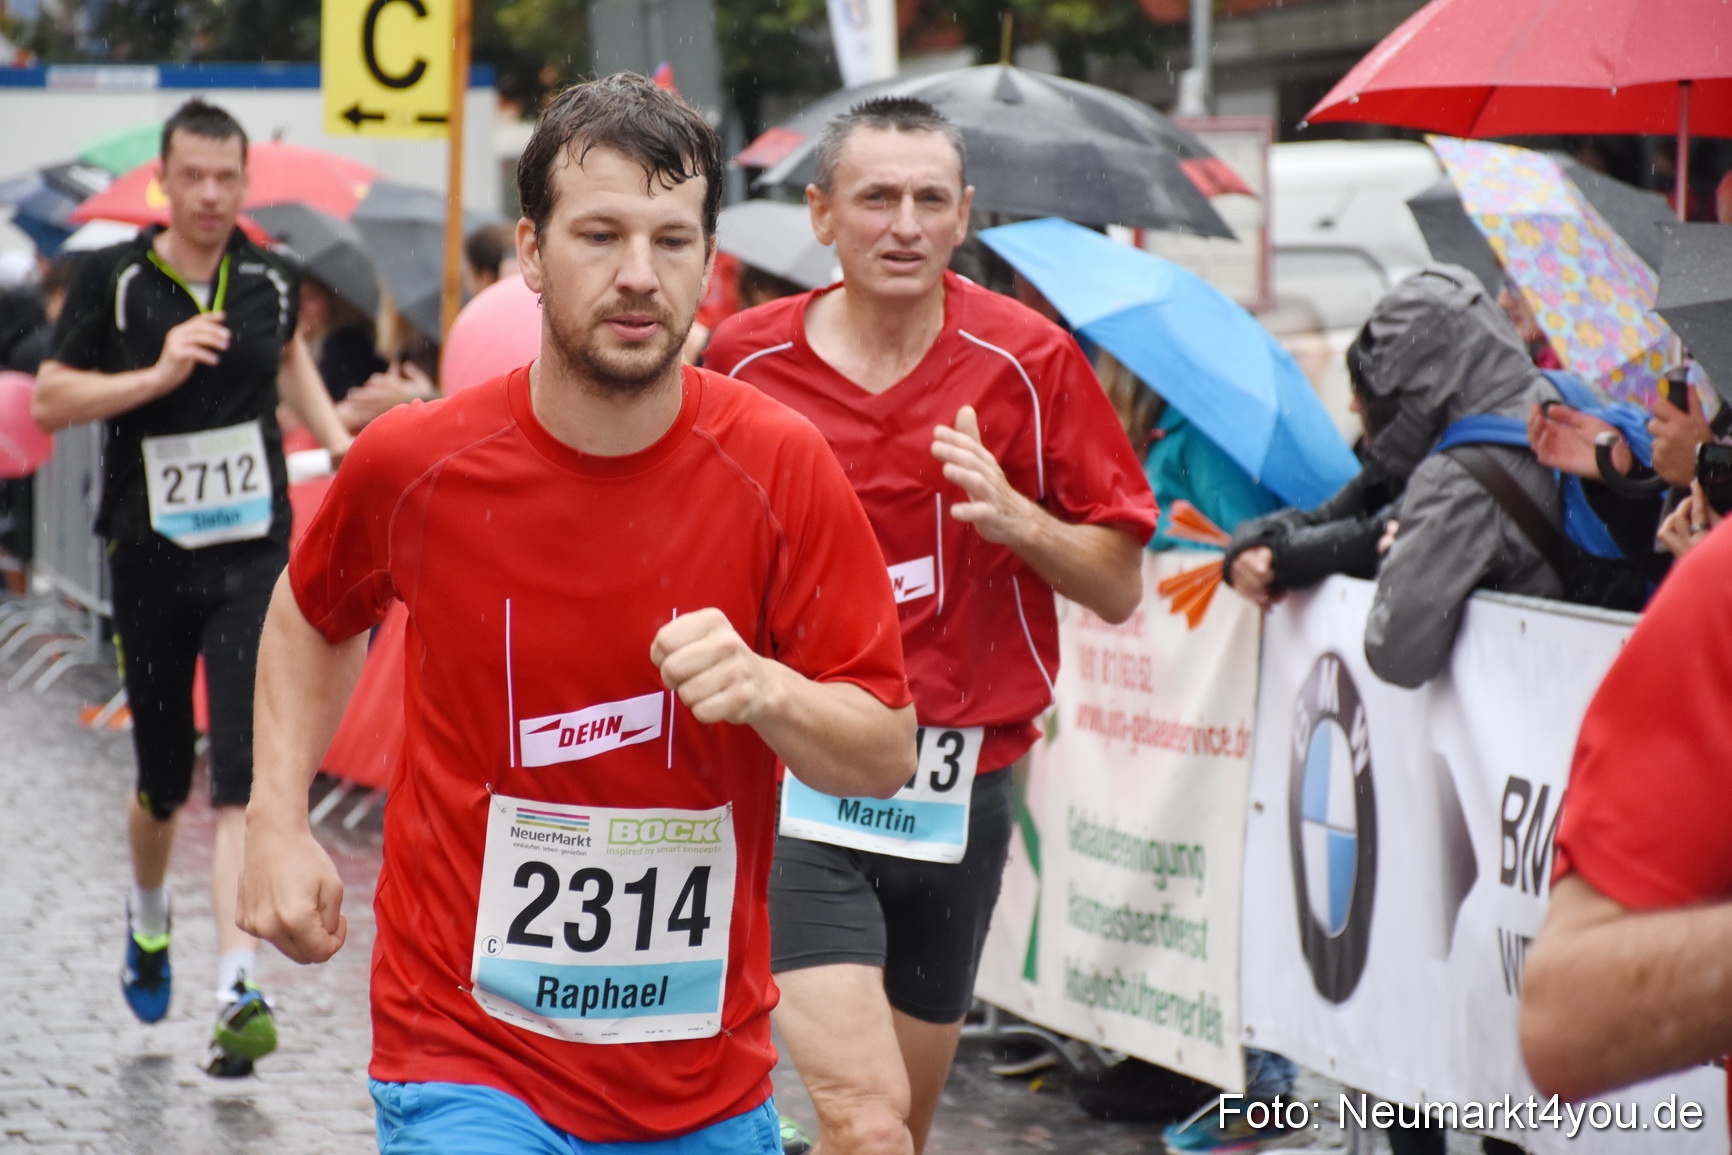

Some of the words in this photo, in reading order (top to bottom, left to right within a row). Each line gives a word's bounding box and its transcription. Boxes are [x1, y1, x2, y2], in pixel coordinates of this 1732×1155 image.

[363, 0, 427, 89] C
[162, 454, 258, 504] 2712
[558, 715, 624, 748] DEHN
[904, 727, 965, 793] 13
[510, 826, 592, 848] NeuerMarkt
[608, 817, 722, 845] BOCK
[837, 798, 916, 834] Martin
[1499, 774, 1567, 898] BM
[606, 845, 642, 857] inspired
[645, 846, 655, 856] by
[656, 844, 681, 854] smart
[682, 844, 722, 855] concepts
[506, 860, 712, 953] 2314
[535, 975, 669, 1017] Raphael
